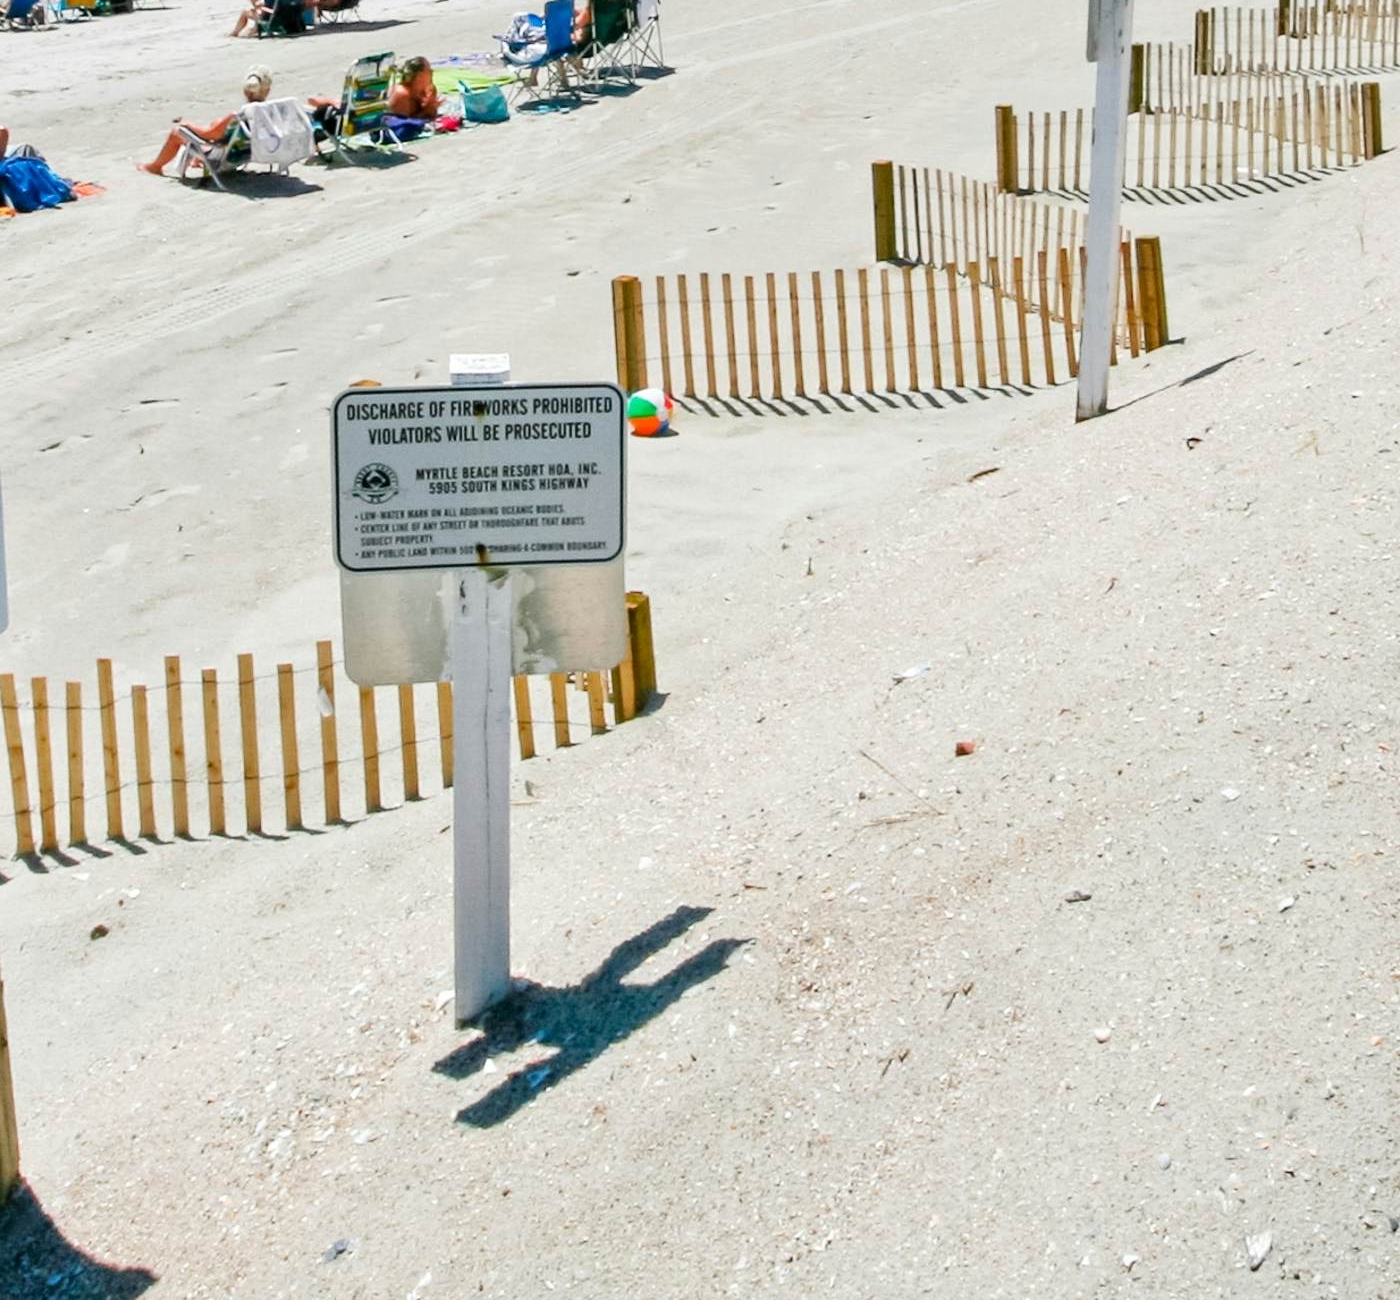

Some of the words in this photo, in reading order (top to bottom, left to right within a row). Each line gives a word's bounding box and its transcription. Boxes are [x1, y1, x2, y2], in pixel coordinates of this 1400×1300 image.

[347, 402, 425, 420] DISCHARGE
[429, 401, 445, 418] OF
[533, 396, 612, 415] PROHIBITED
[368, 425, 442, 445] VIOLATORS
[446, 424, 479, 442] WILL
[483, 424, 500, 441] BE
[505, 421, 591, 440] PROSECUTED
[416, 467, 458, 480] MYRTLE
[462, 465, 498, 479] BEACH
[502, 464, 545, 477] RESORT
[578, 462, 602, 475] INC.
[429, 481, 458, 494] 5905
[461, 480, 497, 493] SOUTH
[501, 478, 535, 491] KINGS
[539, 477, 589, 491] HIGHWAY
[407, 508, 429, 519] MARK
[431, 508, 441, 518] ON
[444, 507, 458, 517] ALL
[501, 505, 533, 515] OCEANIC
[360, 524, 389, 534] CENTER
[392, 523, 409, 533] LINE
[411, 522, 421, 532] OF
[423, 522, 438, 531] ANY
[440, 520, 466, 530] STREET
[468, 520, 478, 529] OR
[542, 516, 559, 526] THAT
[361, 536, 393, 546] SUBJECT
[361, 549, 376, 559] ANY
[378, 548, 406, 559] PUBLIC
[408, 547, 428, 557] LAND
[430, 546, 457, 556] WITHIN
